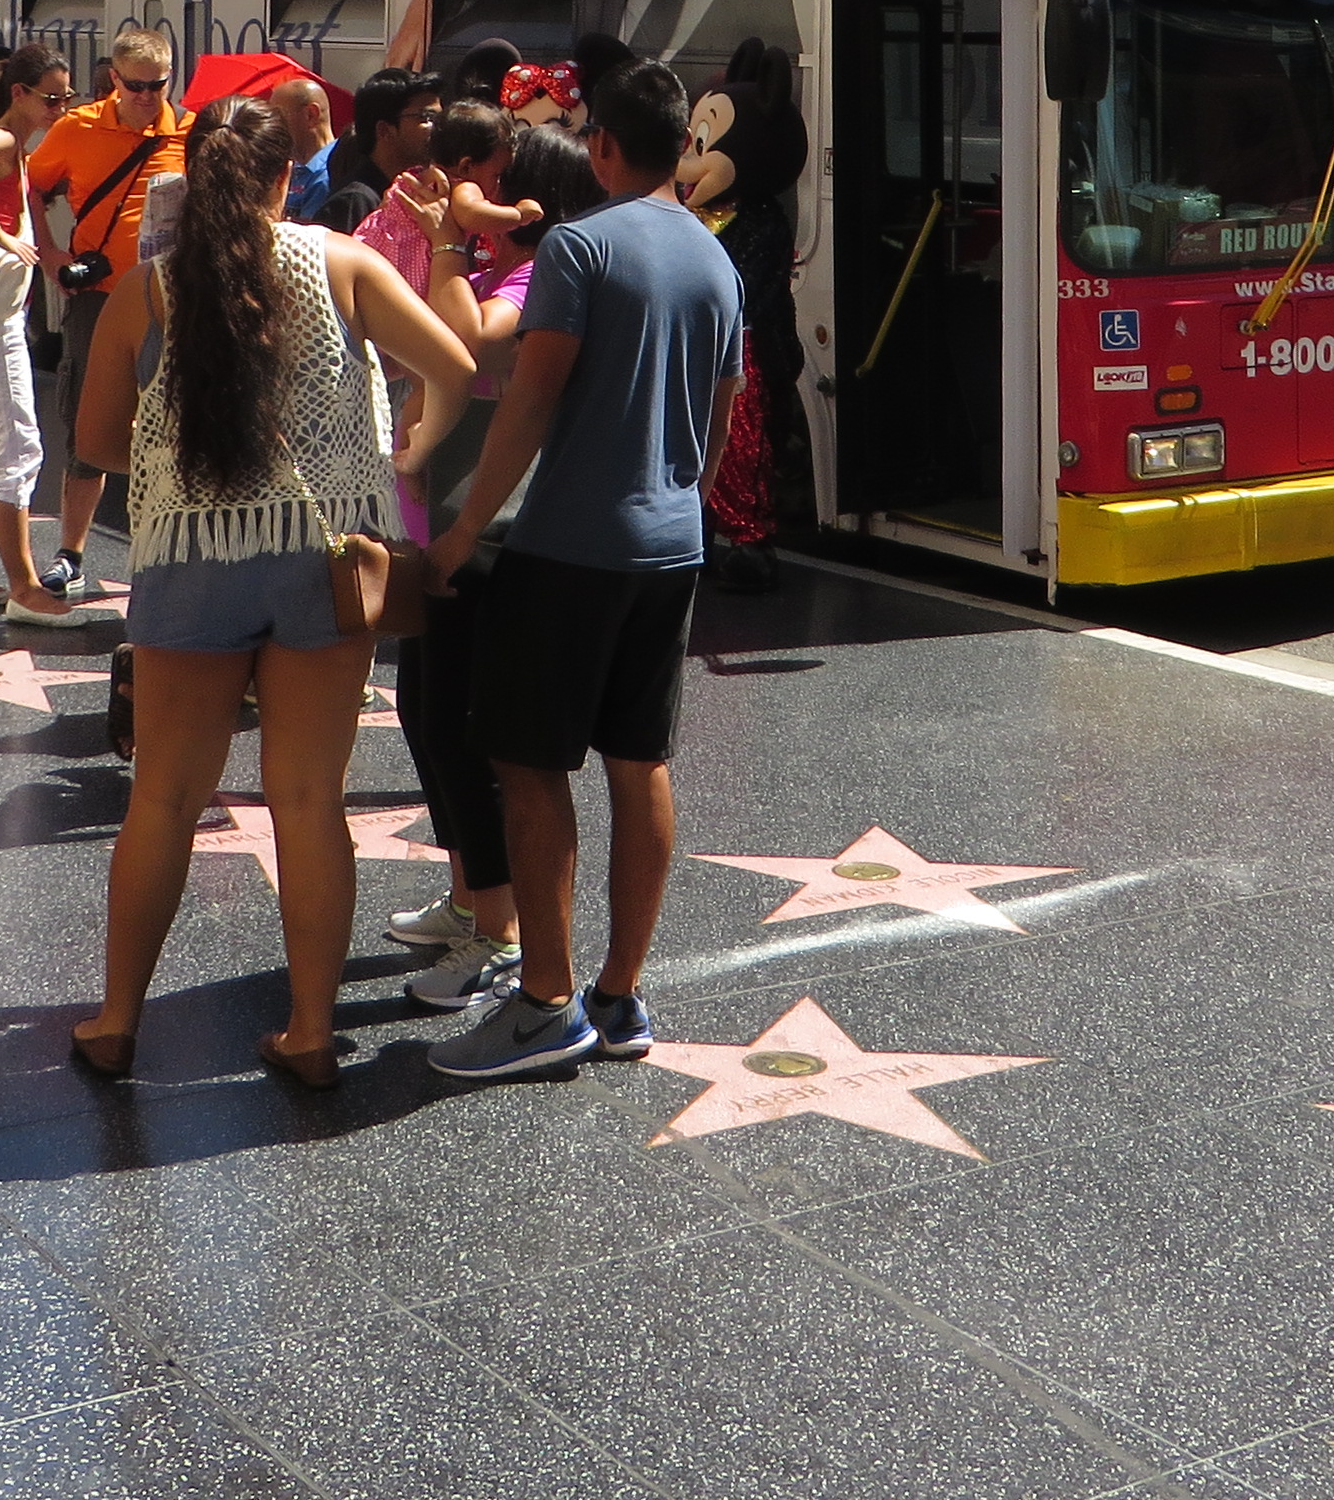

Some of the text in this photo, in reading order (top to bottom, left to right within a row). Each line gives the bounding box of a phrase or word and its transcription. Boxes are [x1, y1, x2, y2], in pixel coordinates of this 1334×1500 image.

[1220, 228, 1257, 253] RED
[1058, 278, 1110, 298] 333
[799, 867, 1001, 908] NICOLE KIDMAN
[728, 1061, 934, 1113] HALLE BERRY
